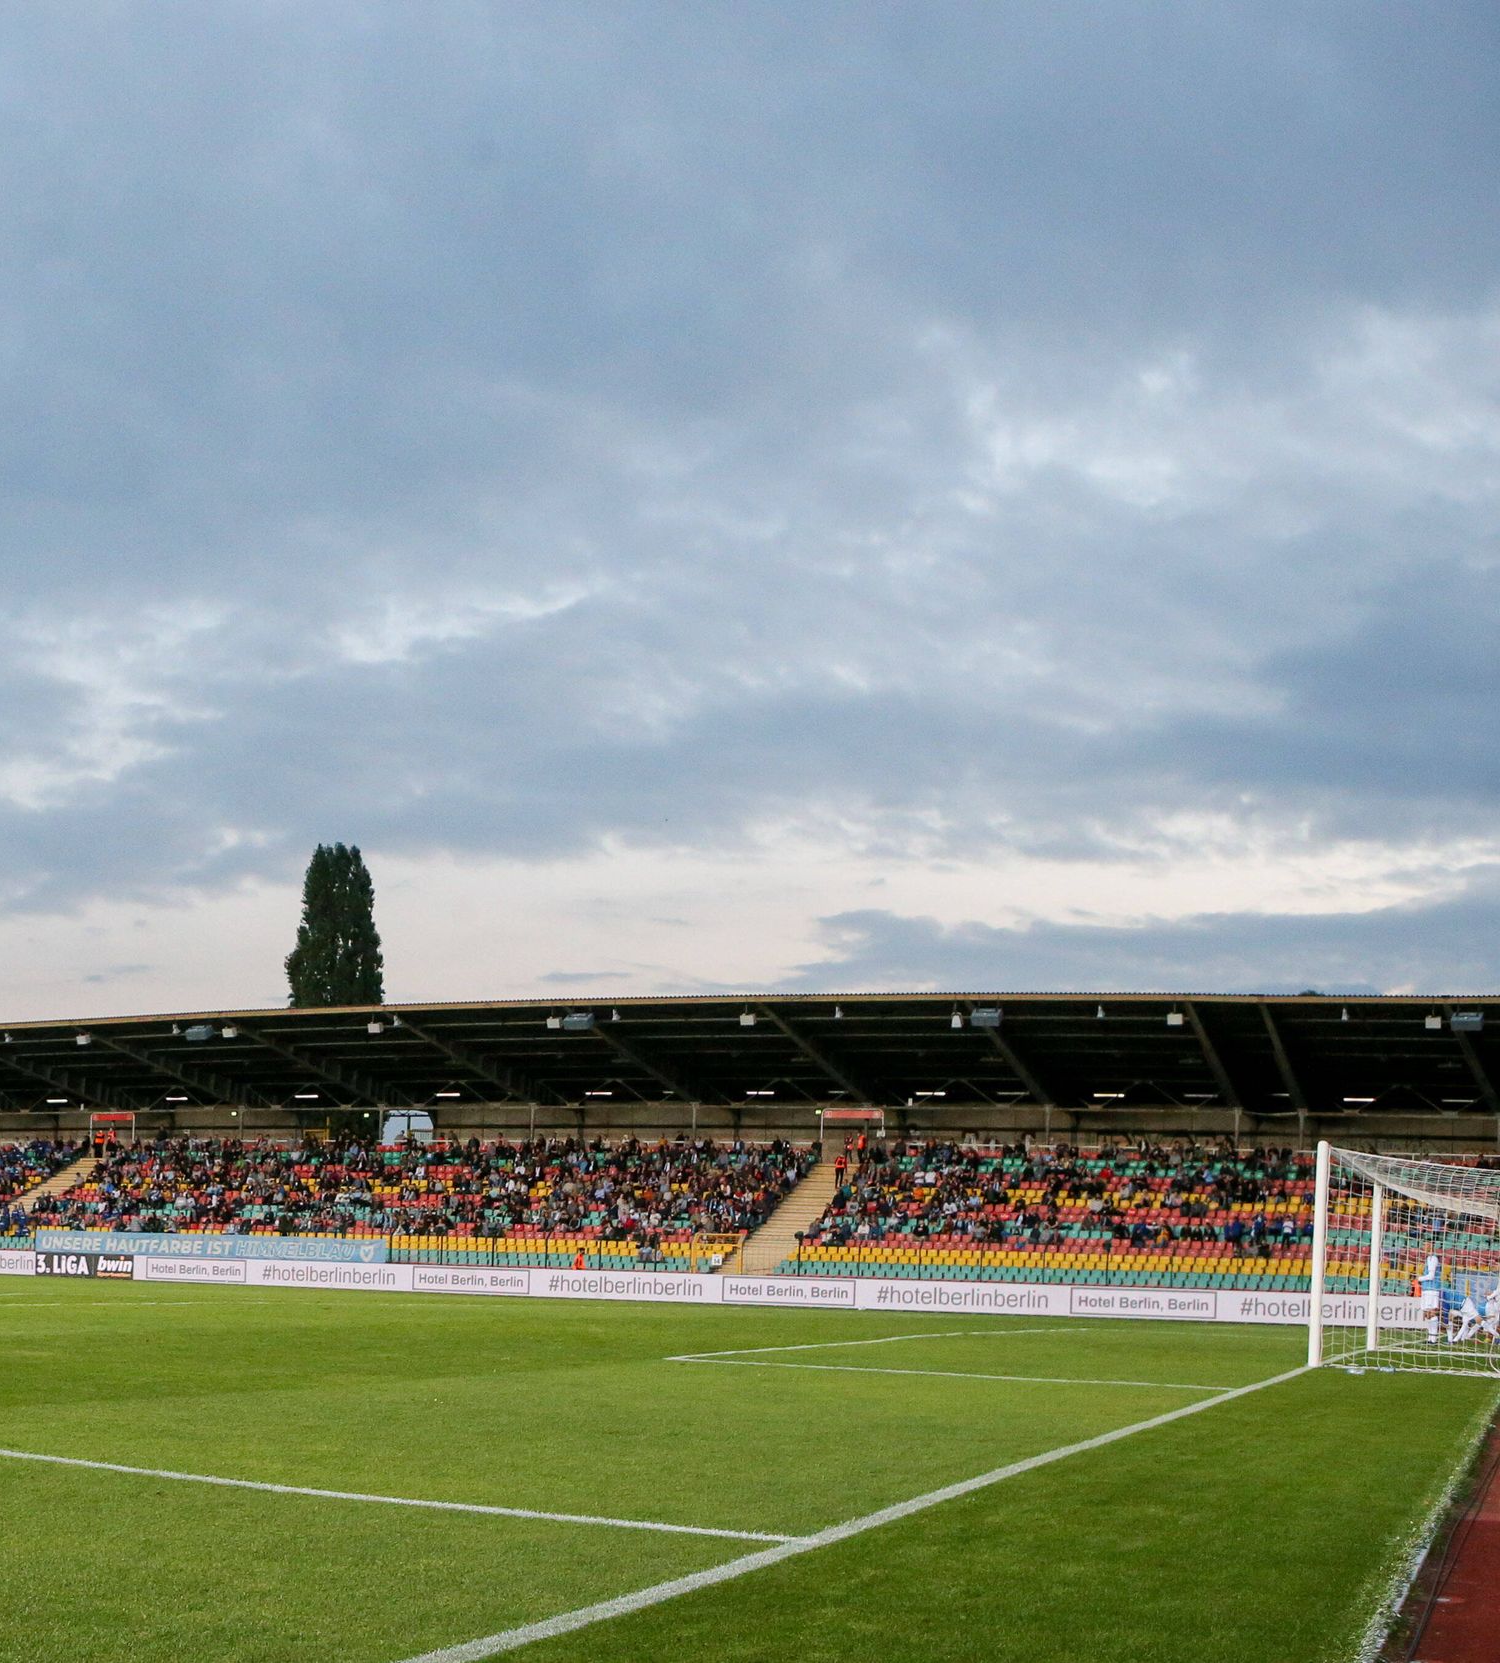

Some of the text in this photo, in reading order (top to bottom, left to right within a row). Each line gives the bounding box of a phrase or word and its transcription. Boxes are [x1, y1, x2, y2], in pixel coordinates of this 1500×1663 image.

[42, 1236, 356, 1259] UNSERE HAUTFARBE IST HIMMELBLAU
[36, 1254, 50, 1274] 3.
[97, 1255, 133, 1272] bwin
[151, 1263, 241, 1276] Hotel Berlin, Berlin
[262, 1265, 396, 1285] #hotelberlinberlin
[419, 1273, 524, 1288] Hotel Berlin, Berlin
[549, 1275, 703, 1297] #hotelberlinberlin
[729, 1283, 849, 1299] Hotel Berlin, Berlin
[876, 1285, 1049, 1309] #hotelberlinberlin
[1078, 1295, 1209, 1312] Hotel Berlin, Berlin
